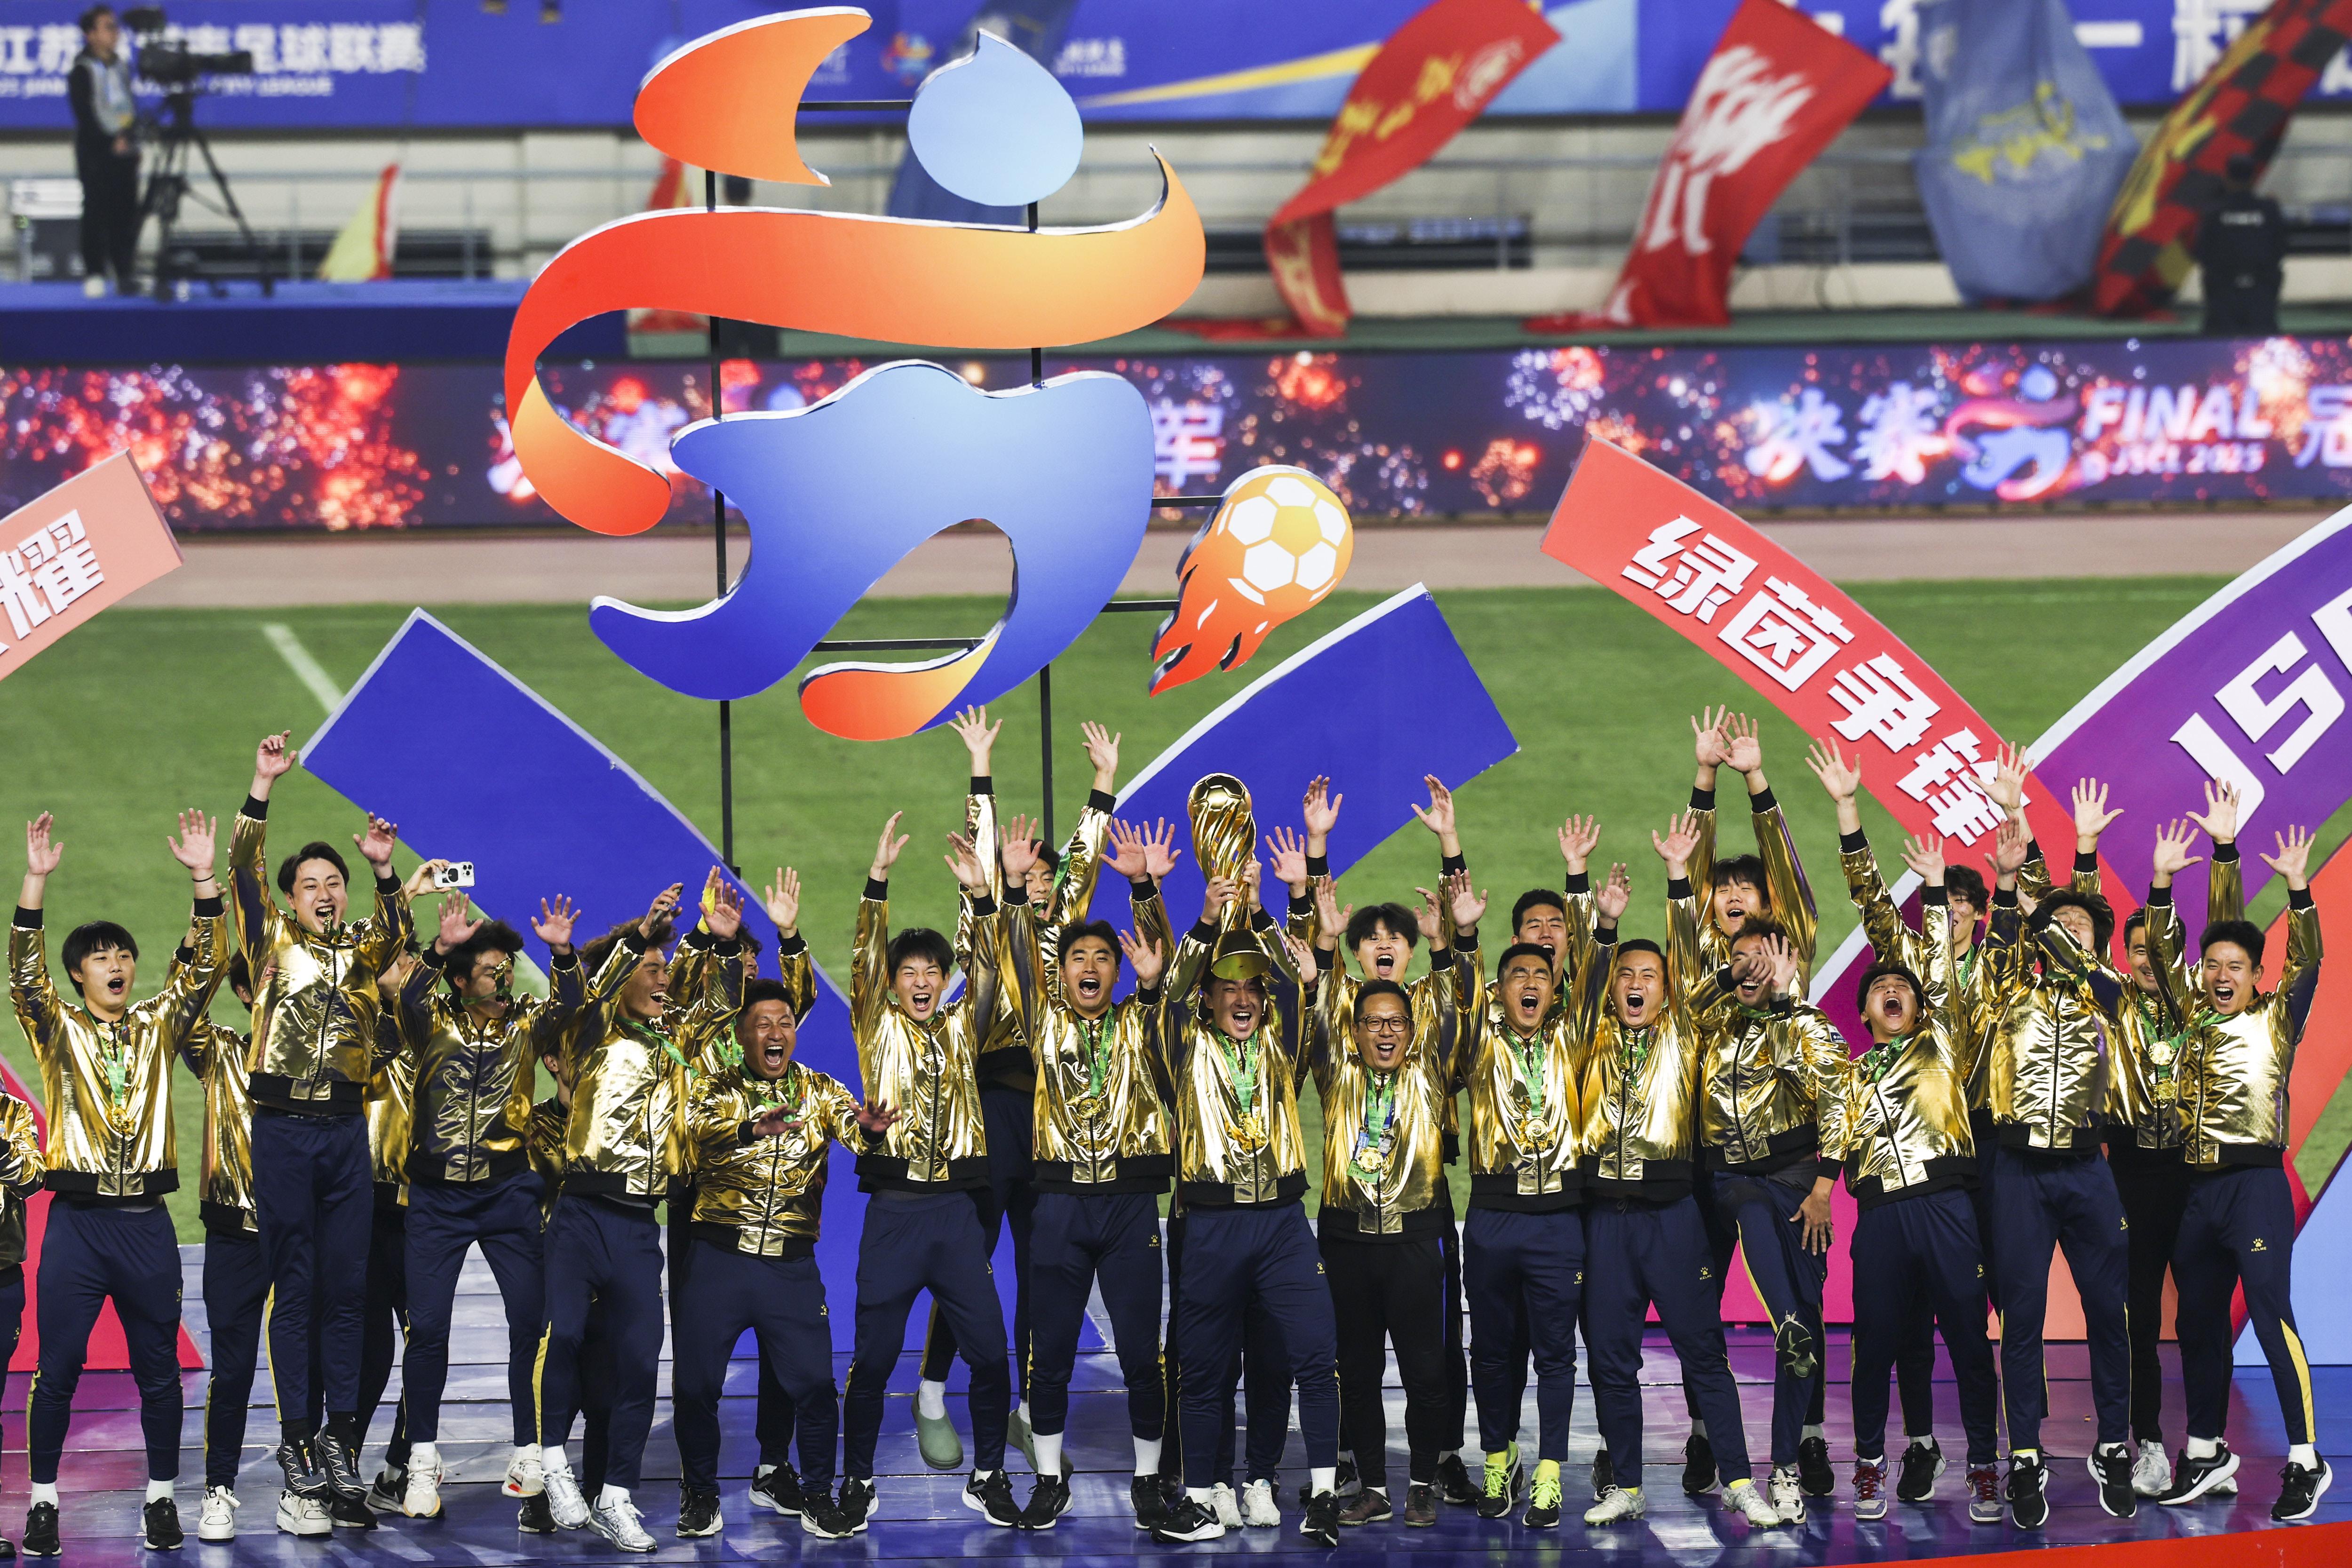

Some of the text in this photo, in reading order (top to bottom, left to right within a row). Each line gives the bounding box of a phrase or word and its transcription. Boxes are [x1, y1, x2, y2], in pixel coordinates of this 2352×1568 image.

[1743, 381, 1948, 484] 决赛
[2081, 383, 2273, 442] FINAL
[1621, 514, 2031, 847] 绿茵争锋
